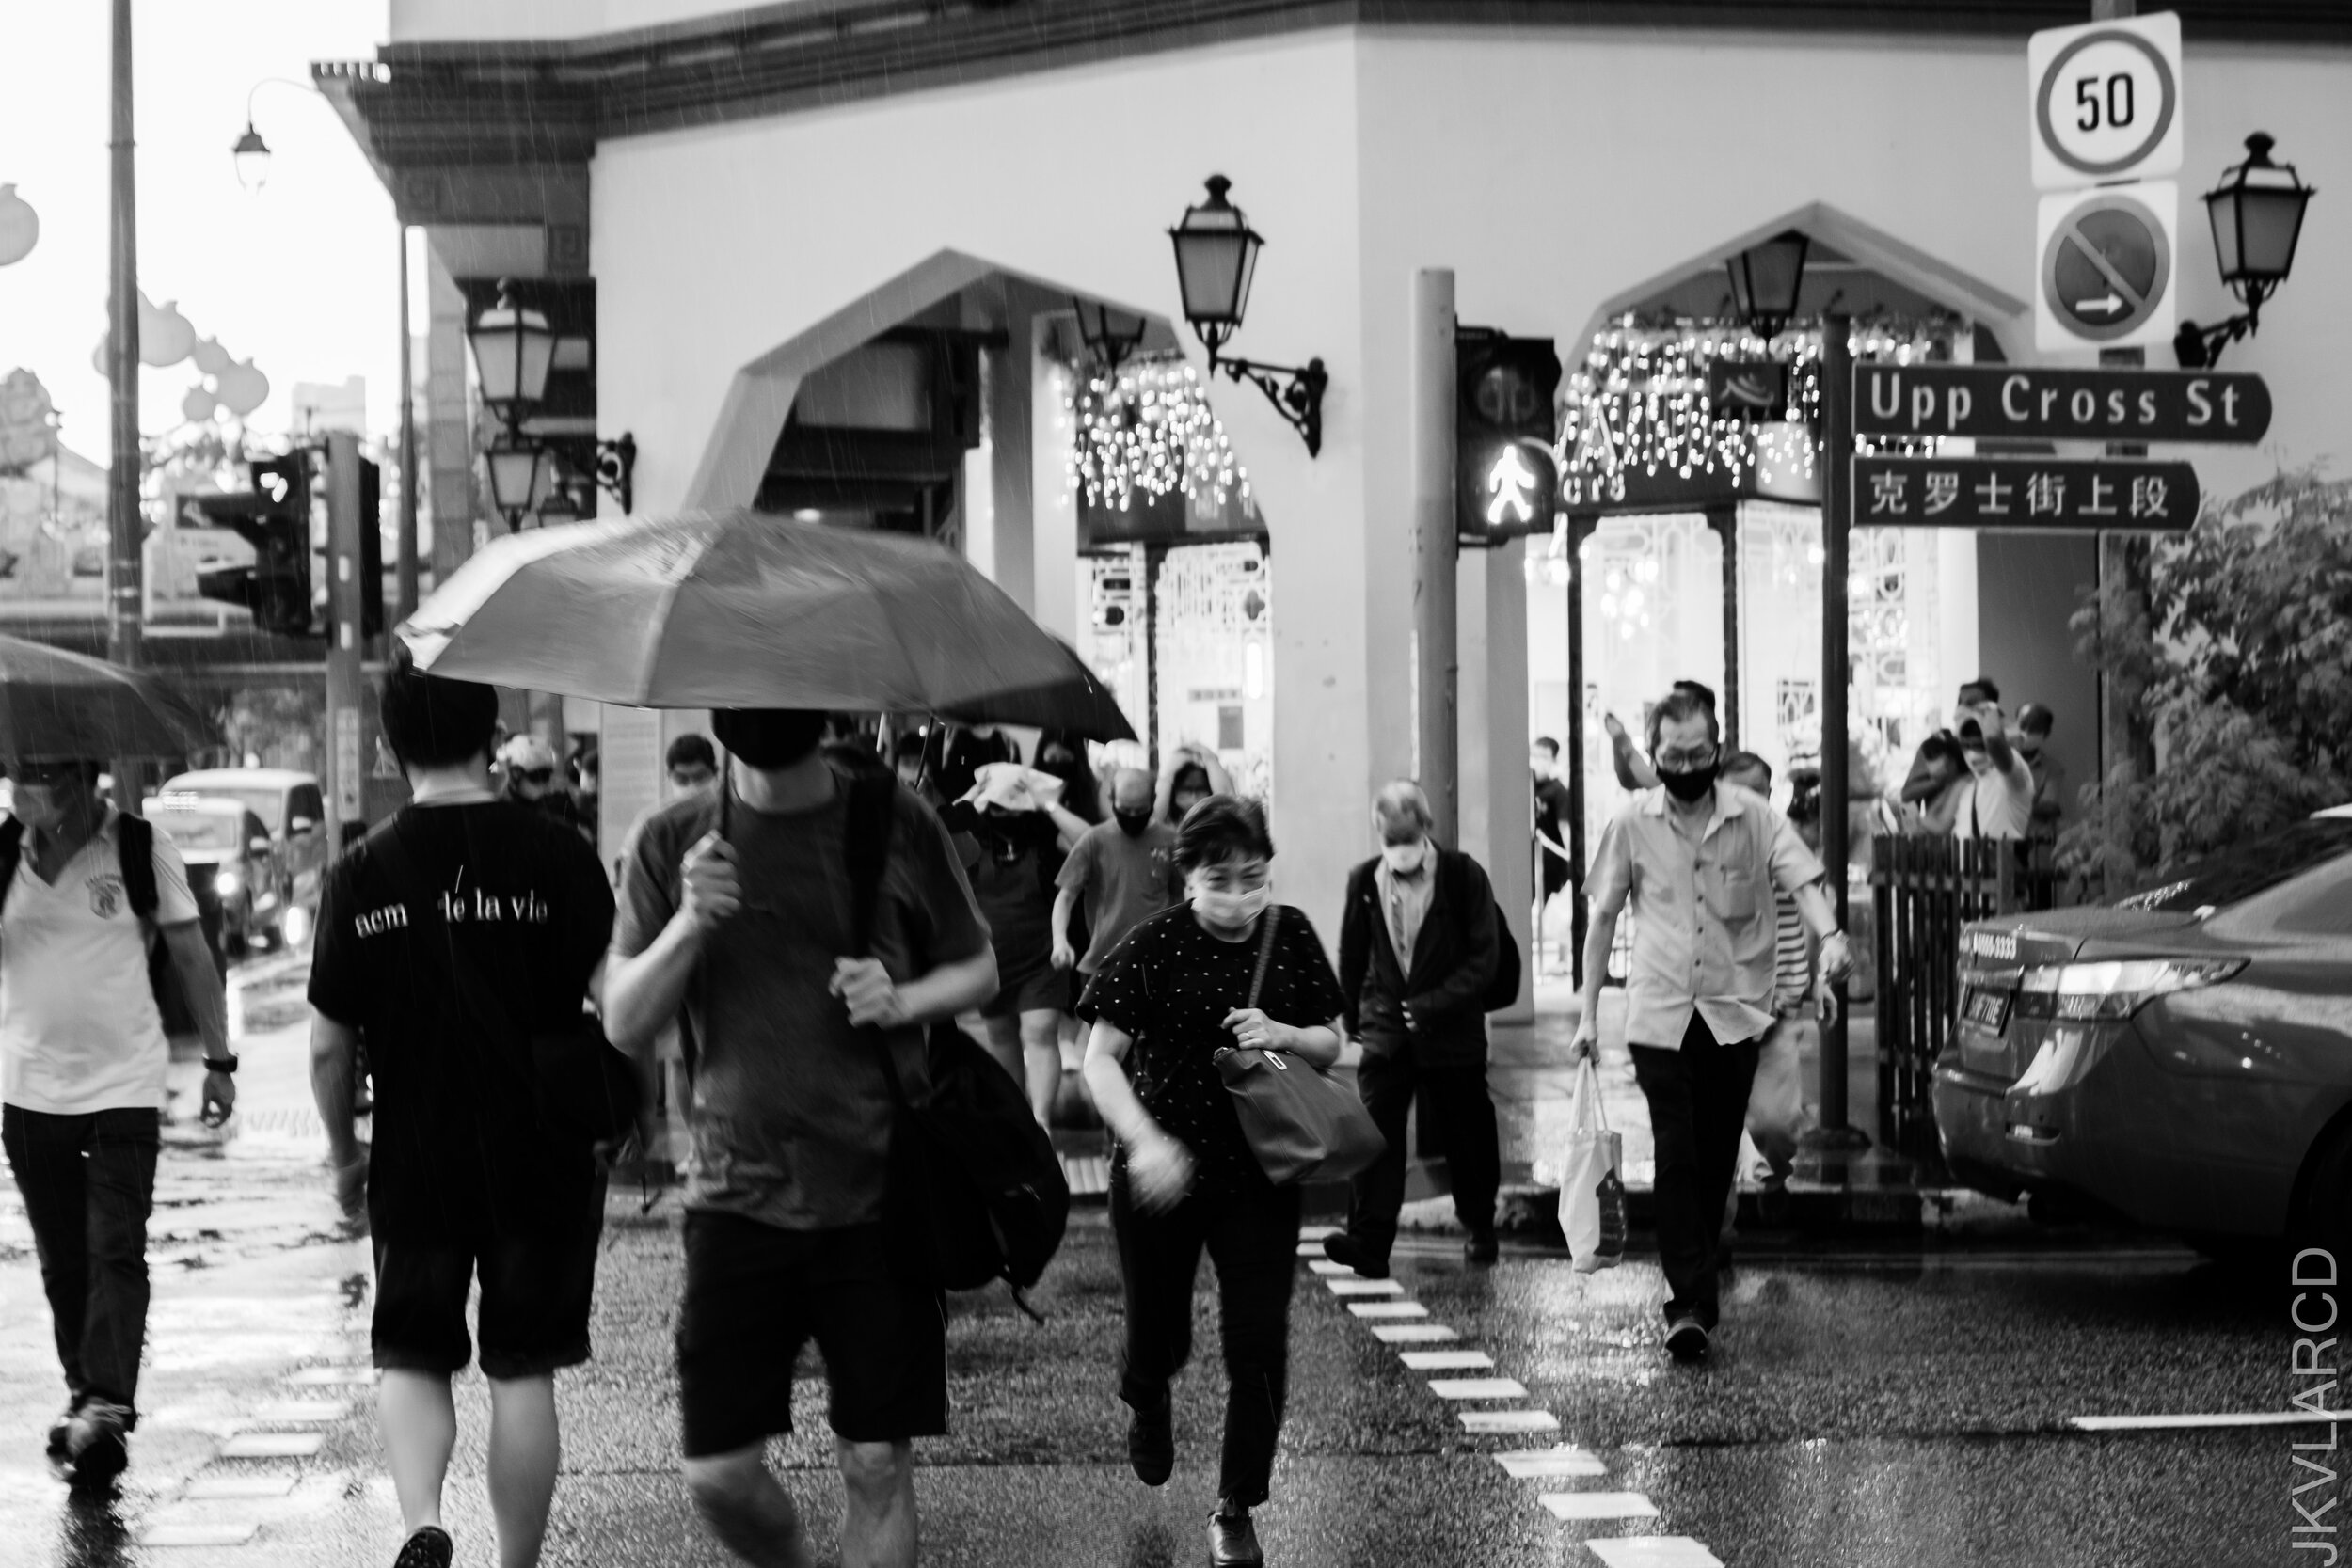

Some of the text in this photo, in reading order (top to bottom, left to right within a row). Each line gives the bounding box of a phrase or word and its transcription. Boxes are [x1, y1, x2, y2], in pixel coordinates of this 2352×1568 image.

[2076, 72, 2134, 132] 50
[1871, 372, 2240, 430] Upp Cross St
[1869, 470, 2169, 518] 克罗士街上段
[475, 887, 501, 921] la
[511, 889, 548, 924] vie
